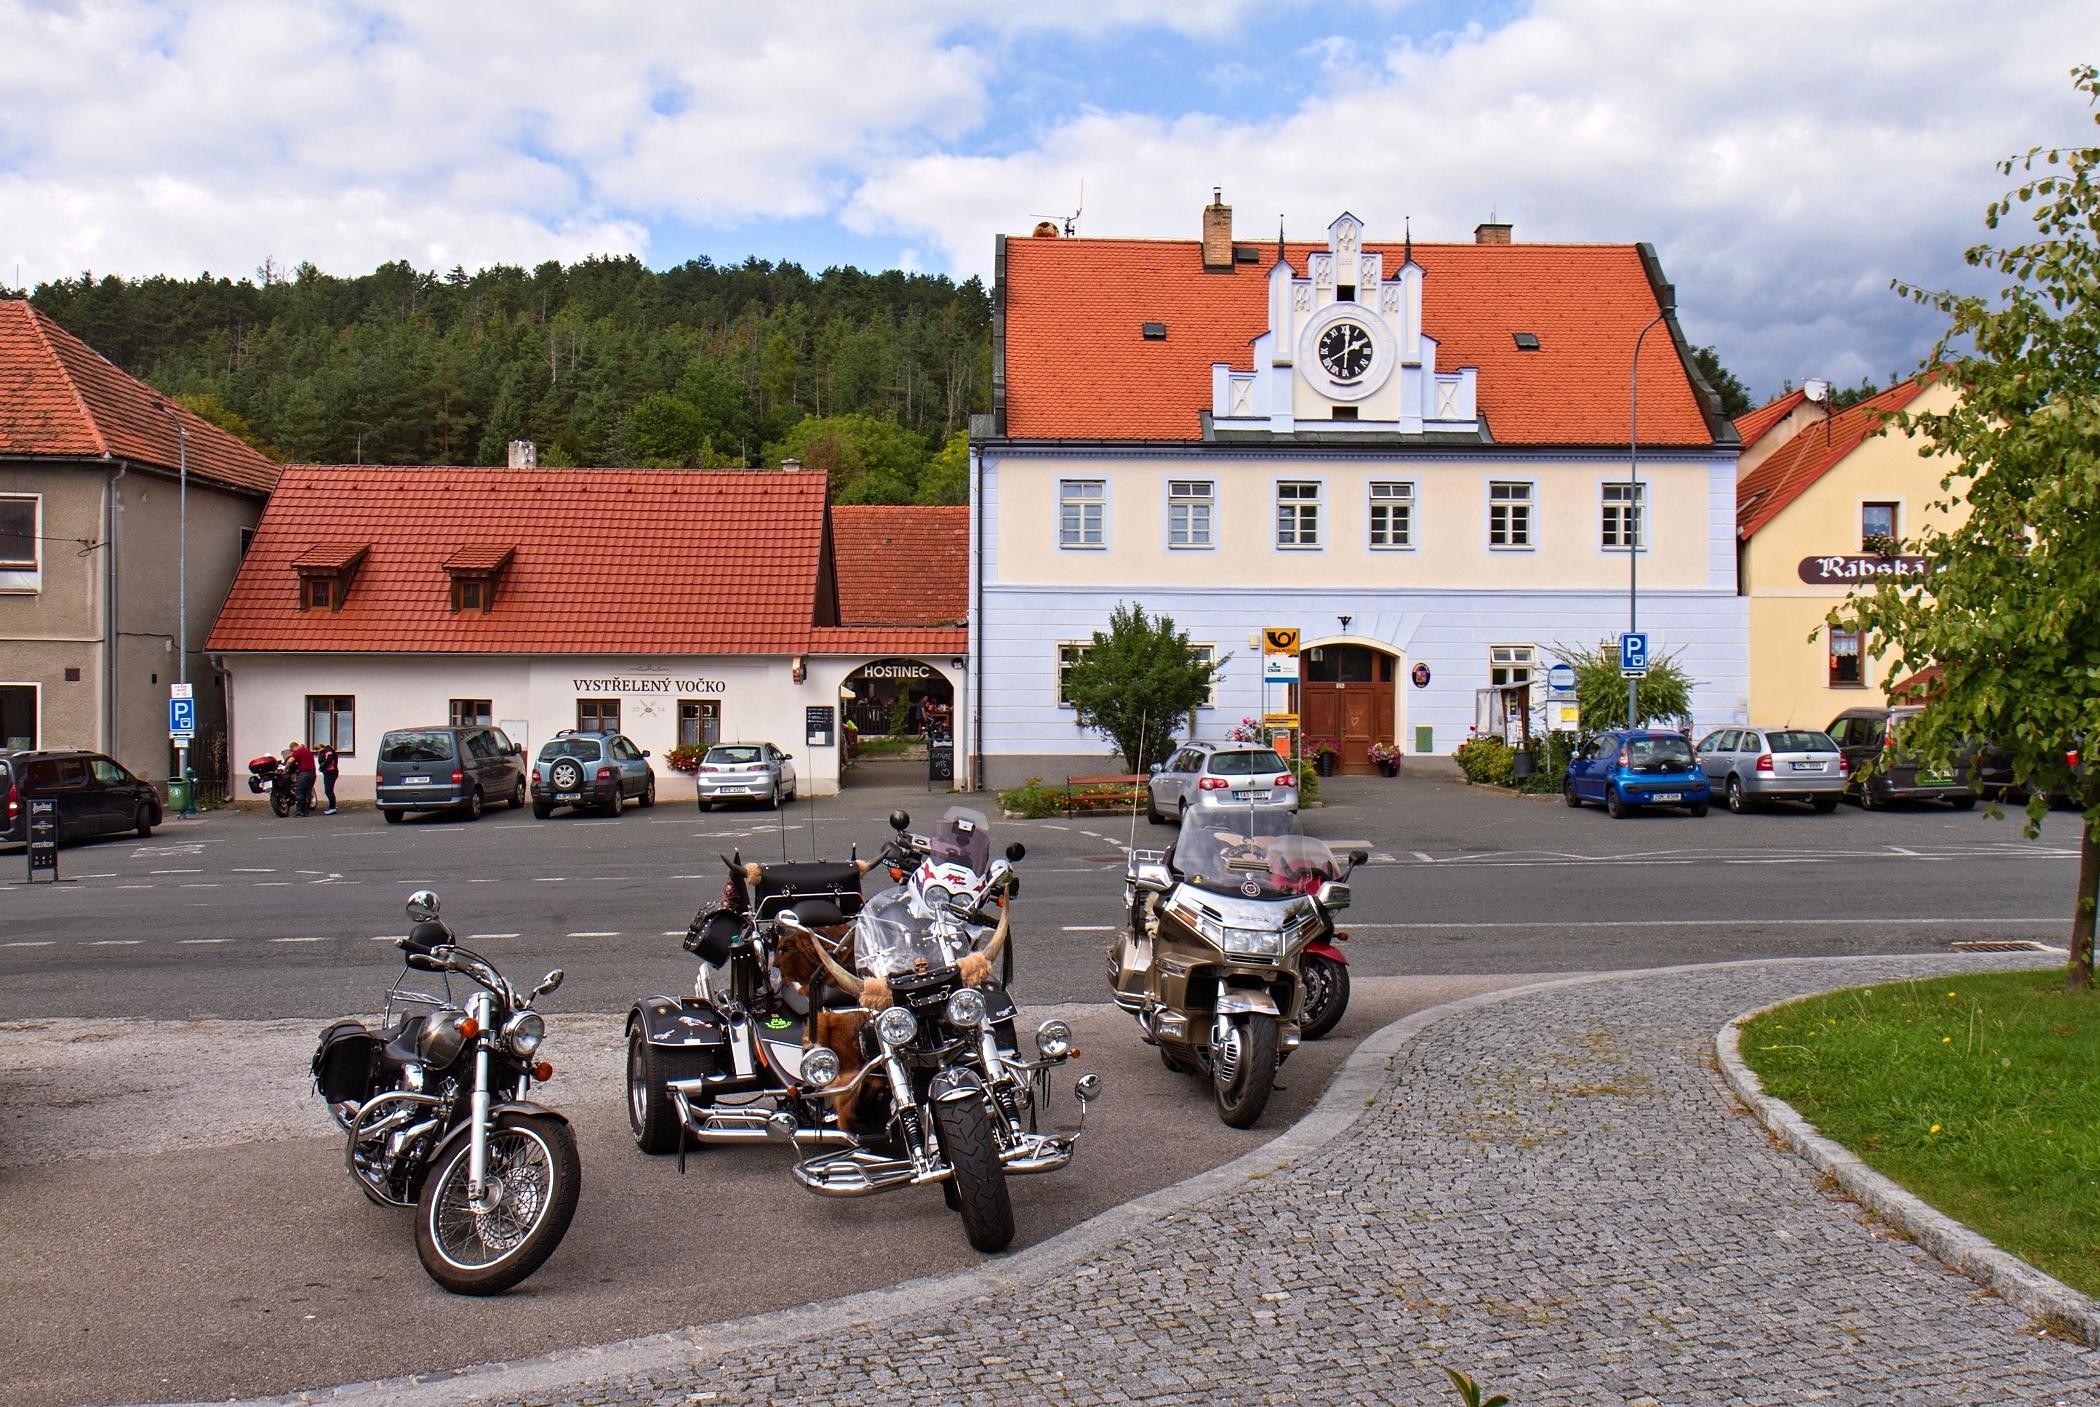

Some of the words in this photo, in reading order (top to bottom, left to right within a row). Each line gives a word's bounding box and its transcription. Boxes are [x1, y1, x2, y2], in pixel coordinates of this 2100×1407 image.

[1627, 637, 1642, 658] P
[864, 666, 930, 678] HOSTINEC
[573, 677, 672, 692] VYSTŘELENÝ
[675, 678, 726, 692] VOČKO
[174, 702, 189, 721] P
